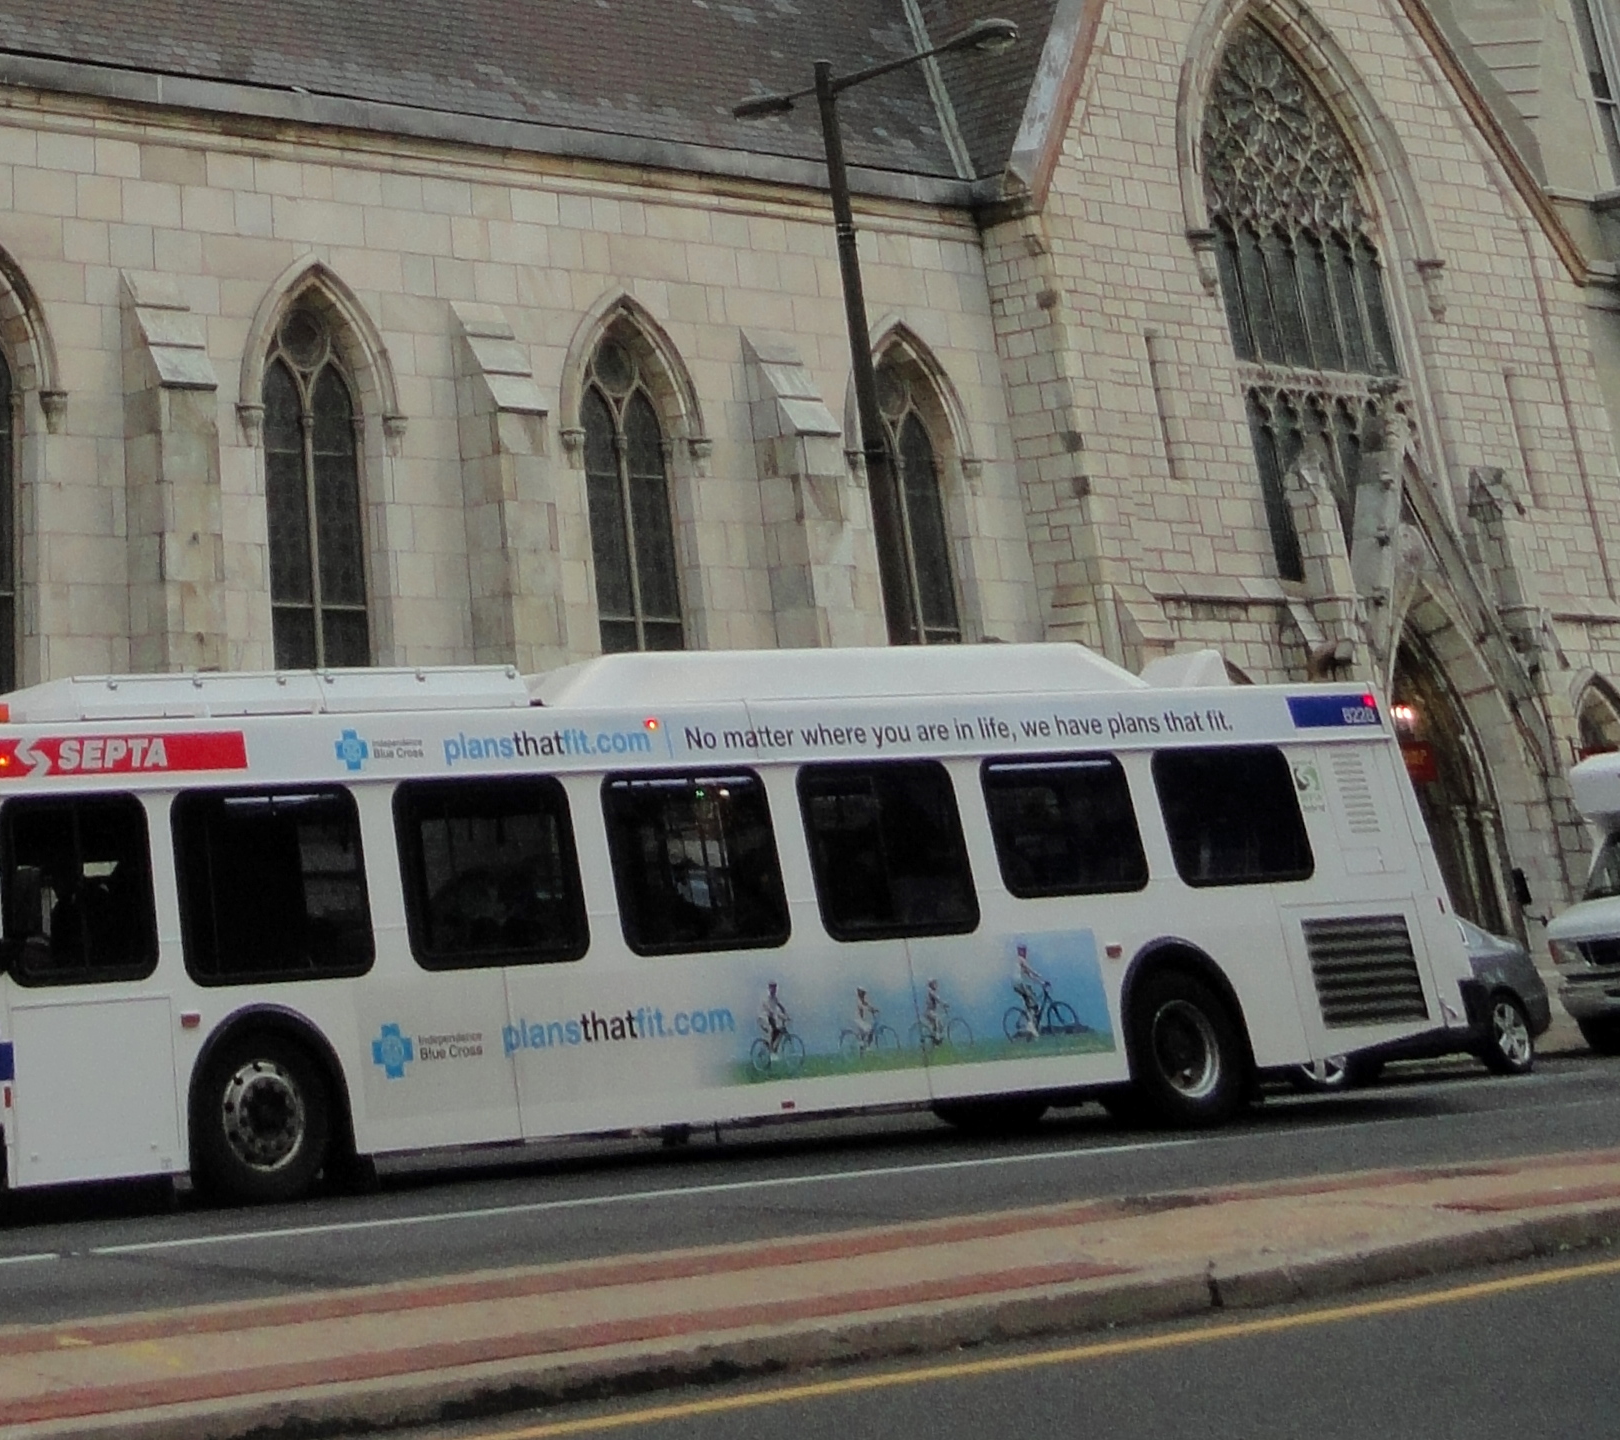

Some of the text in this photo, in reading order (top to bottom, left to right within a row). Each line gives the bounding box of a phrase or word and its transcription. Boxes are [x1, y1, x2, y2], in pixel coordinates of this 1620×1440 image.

[684, 709, 1234, 750] No matter where you are in life, we have plans that fit.
[58, 737, 169, 771] SEPTA
[373, 747, 425, 759] Blue Cross
[442, 729, 651, 767] plansthatfit.com
[502, 1007, 736, 1059] plansthatfit.com
[420, 1044, 484, 1061] Blue Cross
